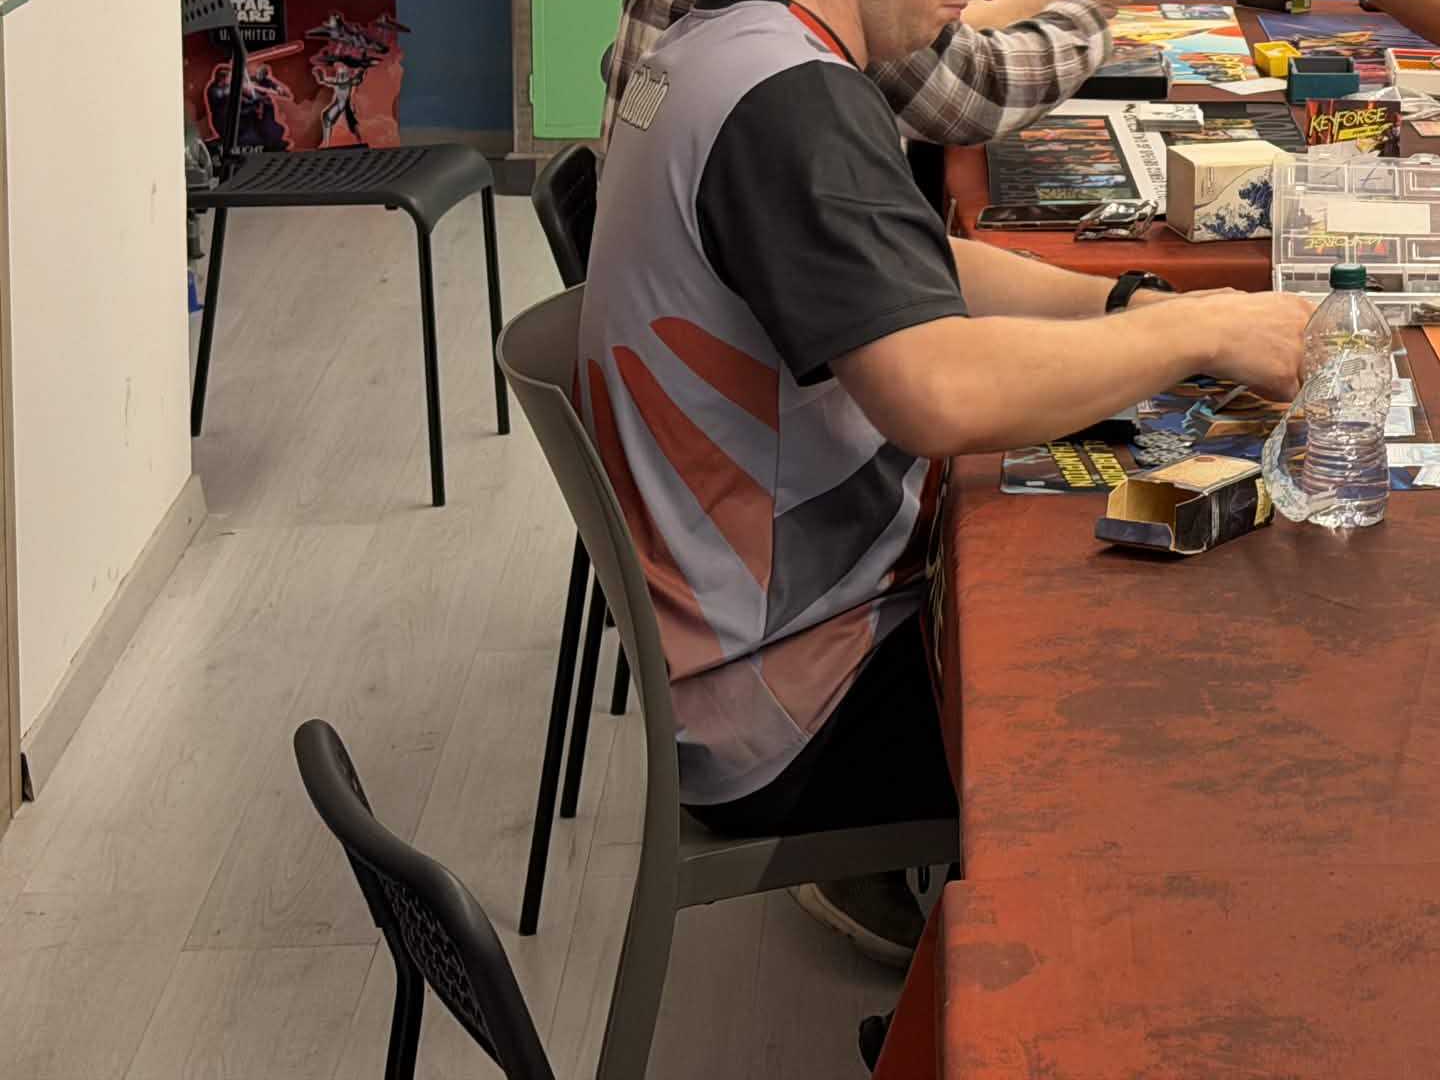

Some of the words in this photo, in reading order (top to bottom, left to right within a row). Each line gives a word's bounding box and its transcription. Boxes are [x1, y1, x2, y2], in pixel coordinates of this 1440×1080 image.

[233, 9, 274, 22] ARS
[219, 28, 276, 40] UIMITED
[1309, 107, 1388, 142] KEYFORGE
